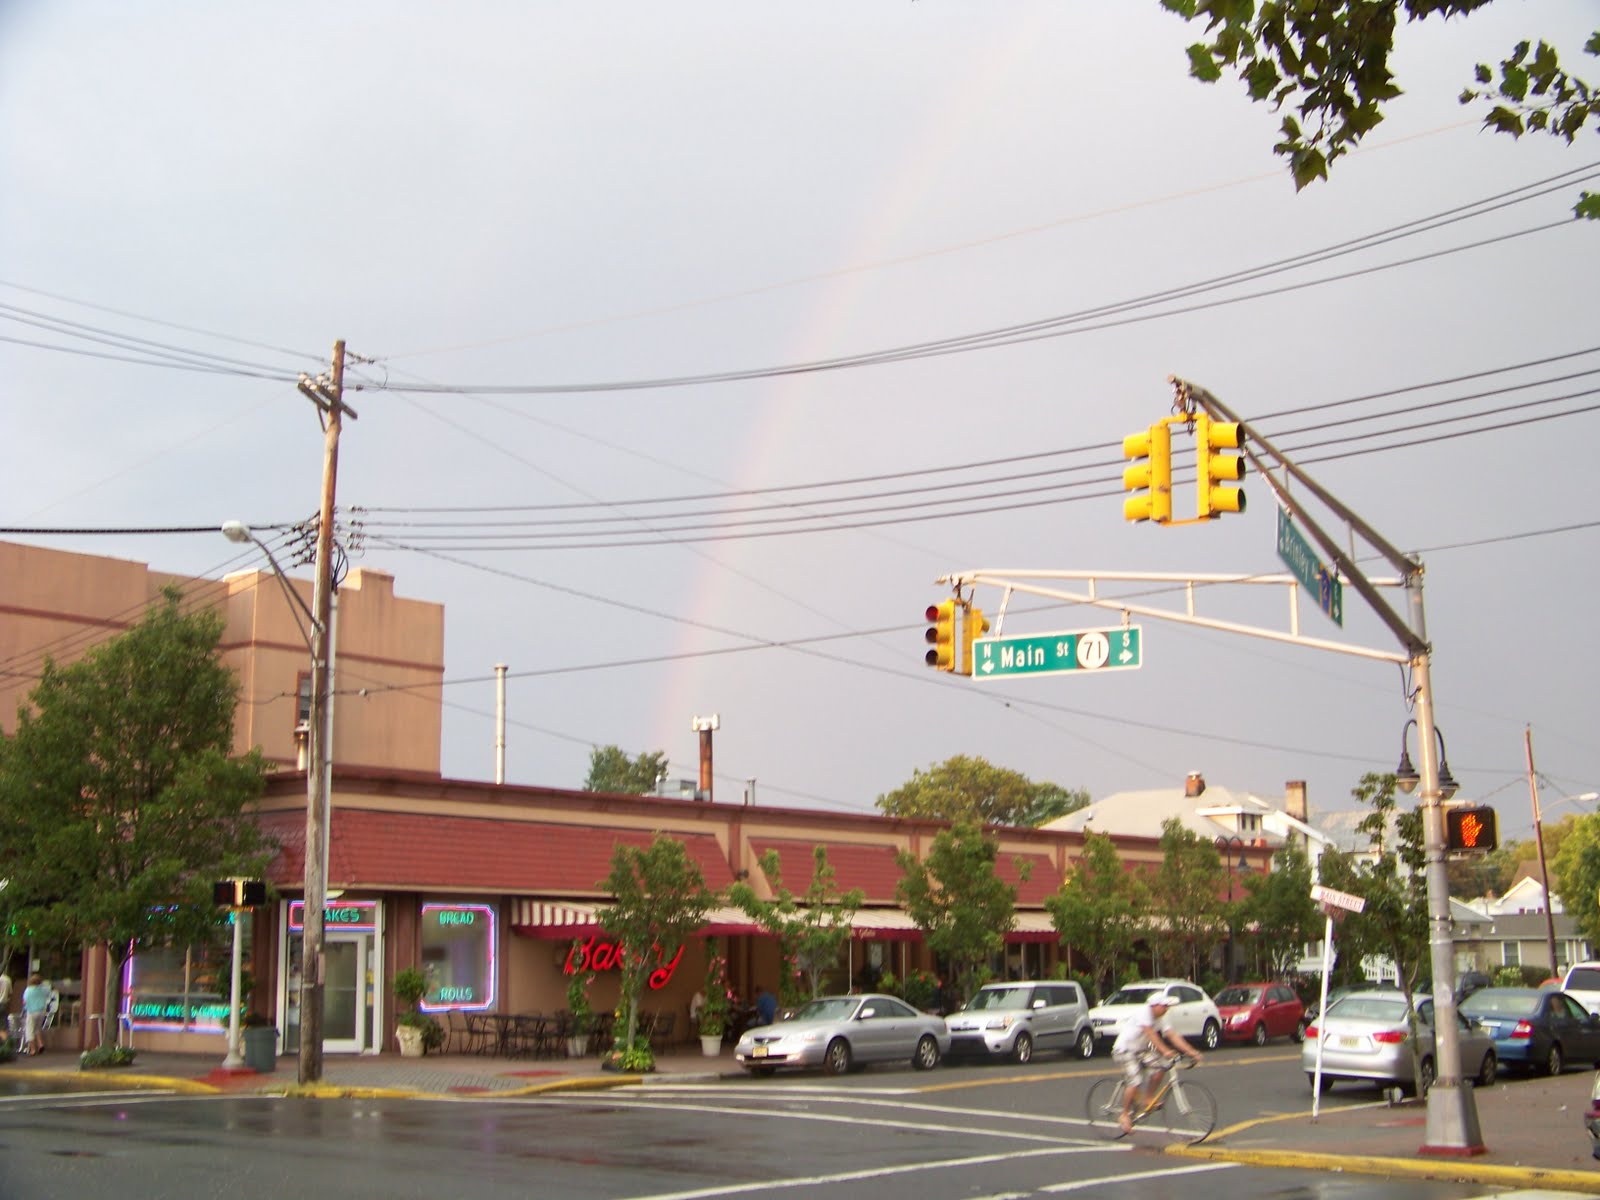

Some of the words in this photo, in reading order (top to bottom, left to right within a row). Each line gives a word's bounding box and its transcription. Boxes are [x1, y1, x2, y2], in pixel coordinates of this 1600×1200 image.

[1122, 632, 1130, 647] S
[983, 644, 991, 658] N
[1001, 645, 1045, 669] Main
[1056, 641, 1069, 657] St
[1084, 640, 1103, 661] 71
[321, 907, 360, 922] AKES
[439, 911, 474, 925] BREAD
[440, 986, 473, 1001] ROLLS
